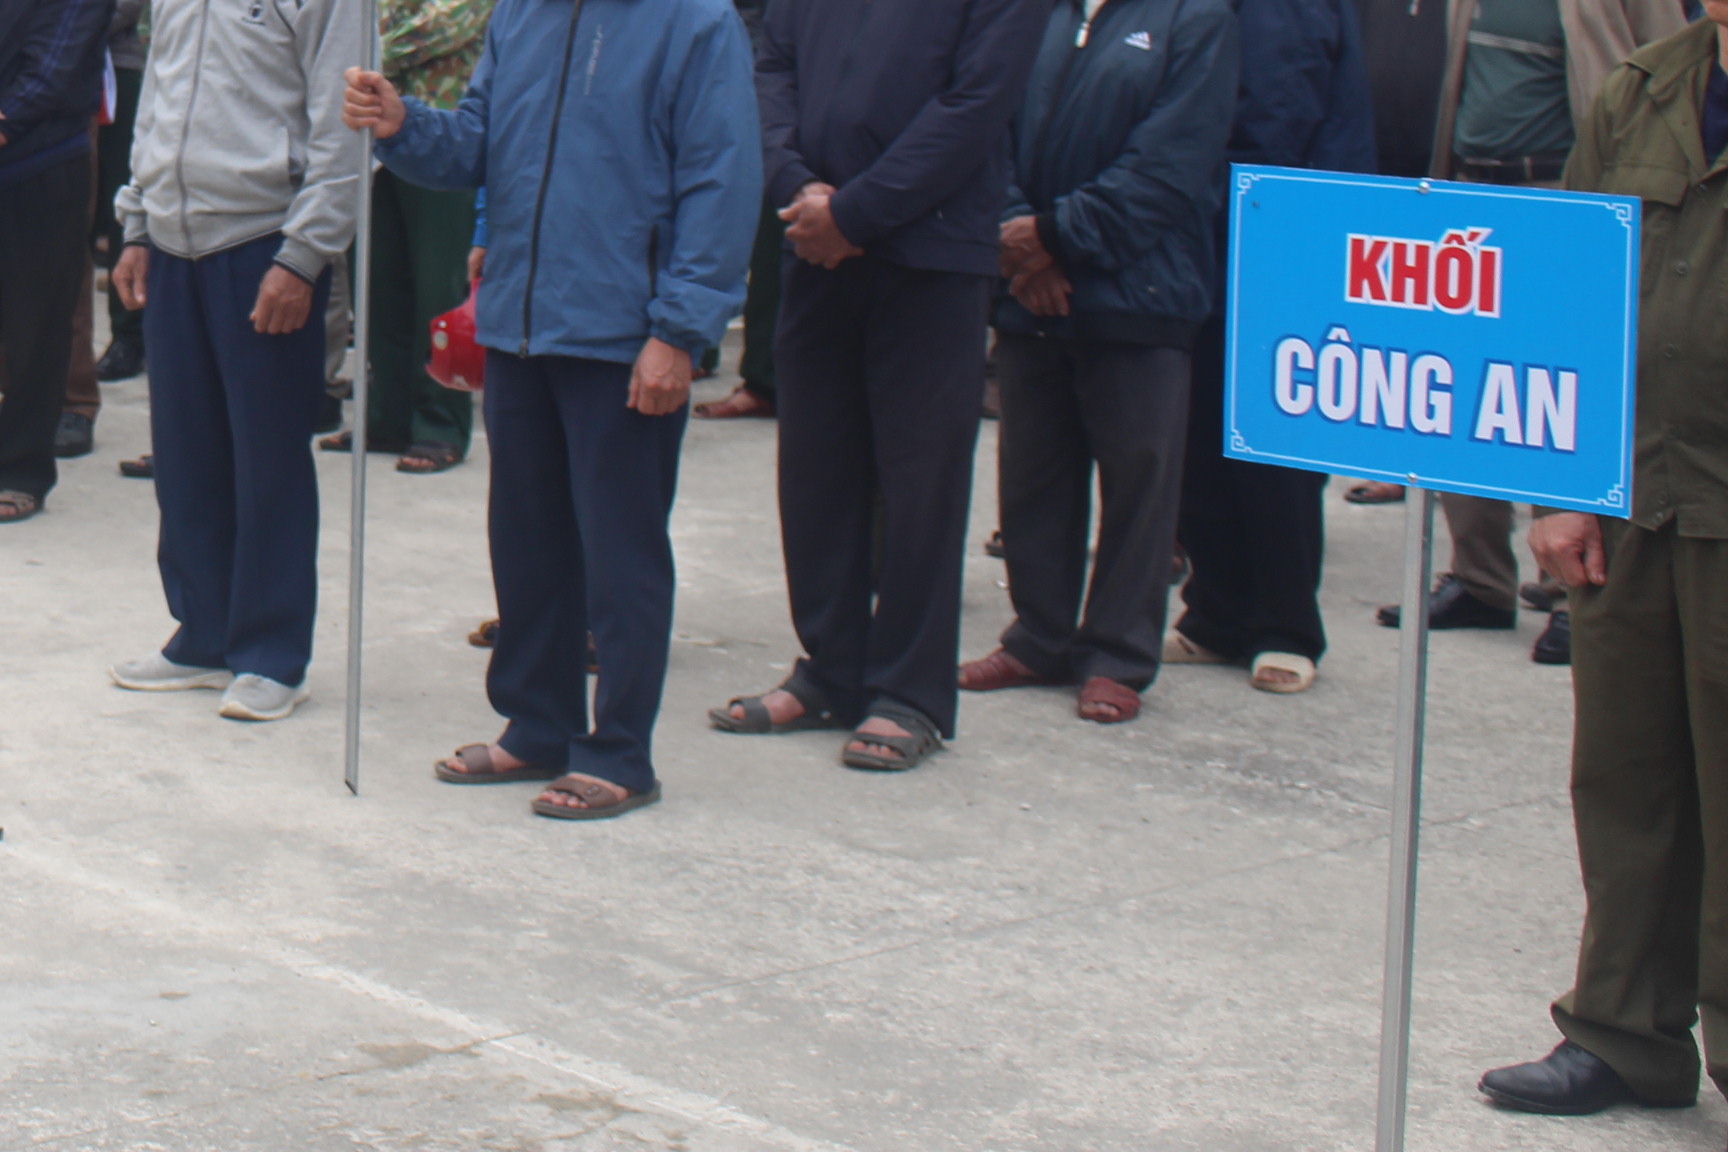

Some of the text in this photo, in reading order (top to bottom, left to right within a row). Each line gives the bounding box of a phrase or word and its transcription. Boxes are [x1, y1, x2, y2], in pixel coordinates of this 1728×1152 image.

[1345, 227, 1503, 319] KHỐI
[1273, 324, 1578, 453] CÔNG AN
